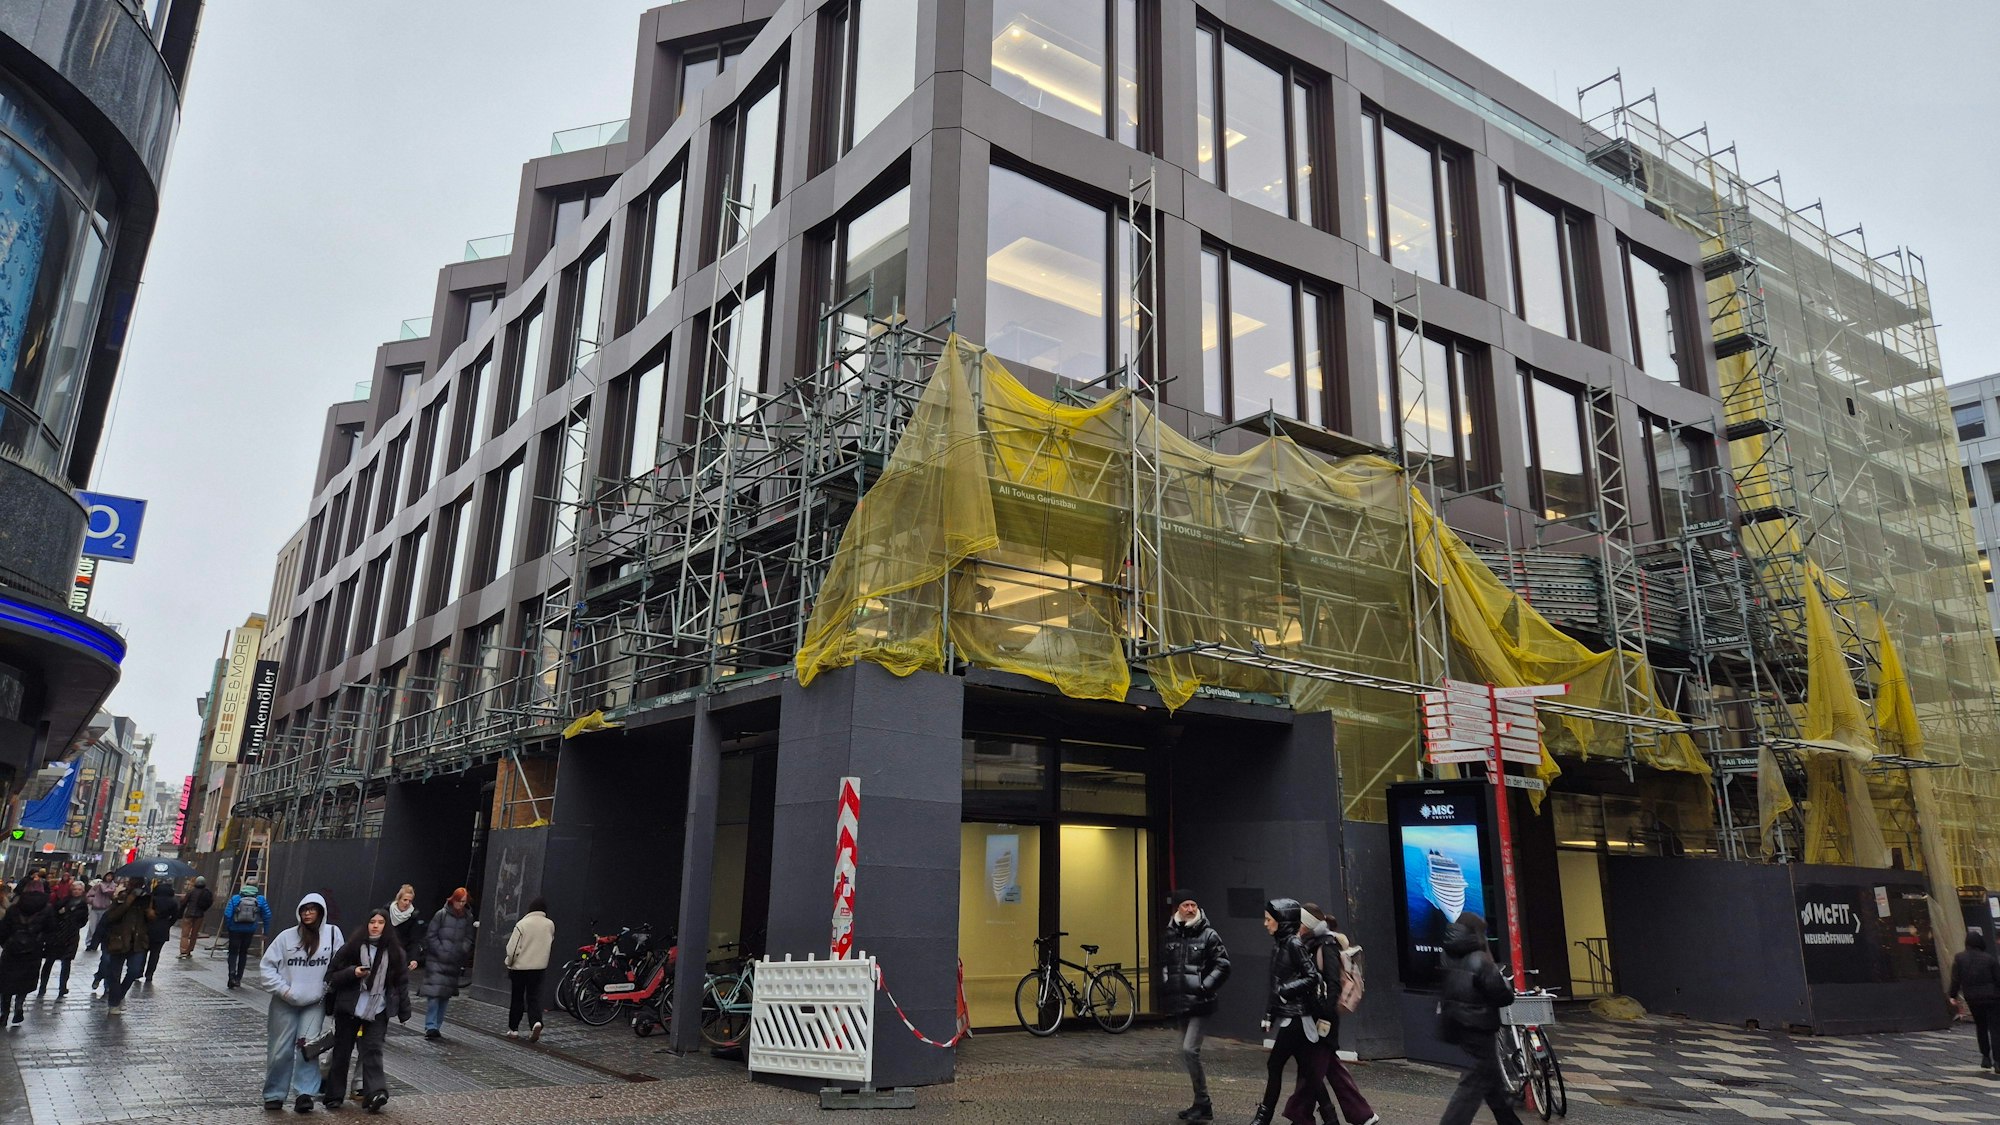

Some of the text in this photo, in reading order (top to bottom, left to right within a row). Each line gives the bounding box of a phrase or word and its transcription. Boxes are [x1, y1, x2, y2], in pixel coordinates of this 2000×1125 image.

[999, 485, 1077, 510] Ali Tokus Gerüstbau
[1699, 520, 1721, 529] Tokus
[1173, 524, 1202, 539] TOKUS
[1707, 636, 1739, 645] Ali Tokus
[231, 633, 251, 678] MORE
[229, 681, 240, 691] &
[1205, 686, 1241, 699] Gerüstbau
[247, 668, 277, 757] hunkemöller
[216, 692, 238, 756] CHEESE
[1505, 777, 1511, 785] In
[1513, 778, 1522, 787] der
[1431, 804, 1455, 816] MSC
[1813, 903, 1850, 925] McFIT
[1804, 932, 1855, 945] NEUERÖFFNUNG
[1416, 944, 1432, 952] BEST
